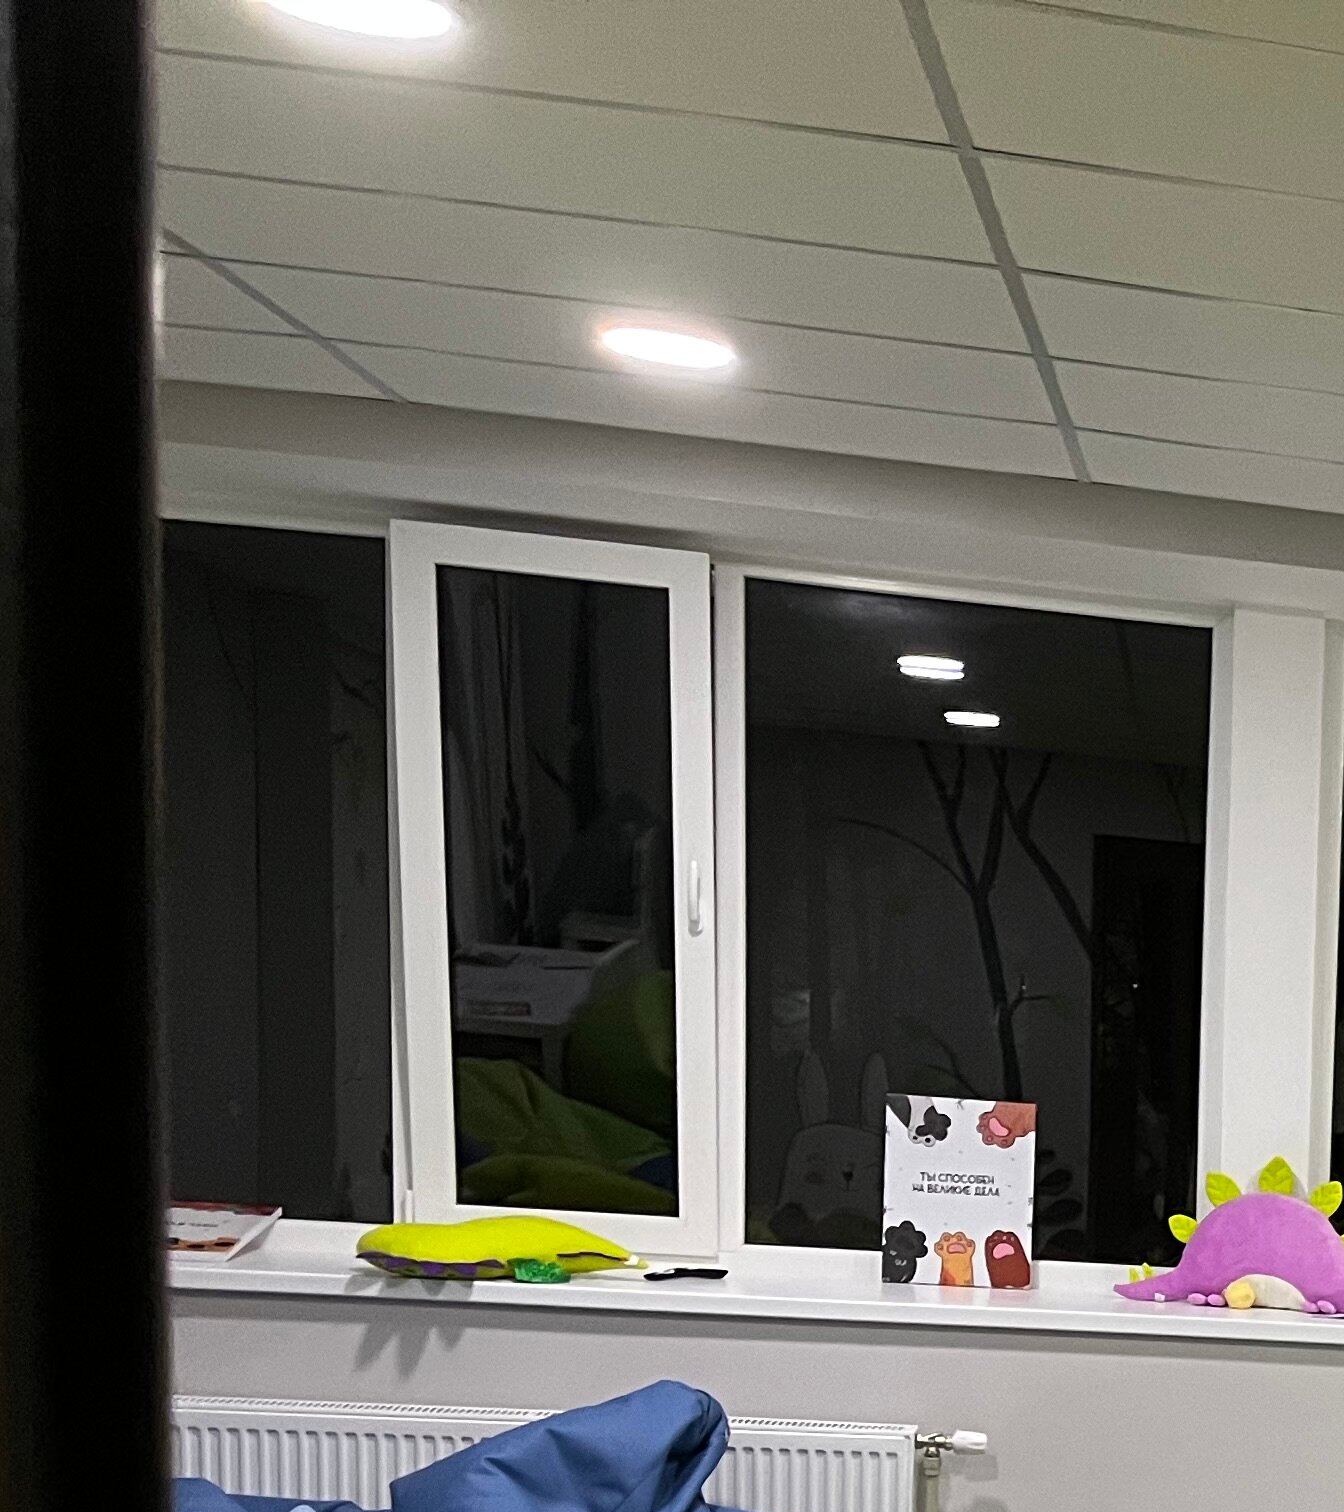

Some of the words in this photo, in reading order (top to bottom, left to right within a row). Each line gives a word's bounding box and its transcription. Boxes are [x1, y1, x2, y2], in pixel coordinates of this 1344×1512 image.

[920, 1171, 936, 1182] ТЫ
[938, 1172, 995, 1185] СПОСОБЕН
[912, 1183, 925, 1192] НА
[927, 1183, 971, 1196] ВЕЛИКИЕ
[974, 1186, 1000, 1197] ДЕЛА
